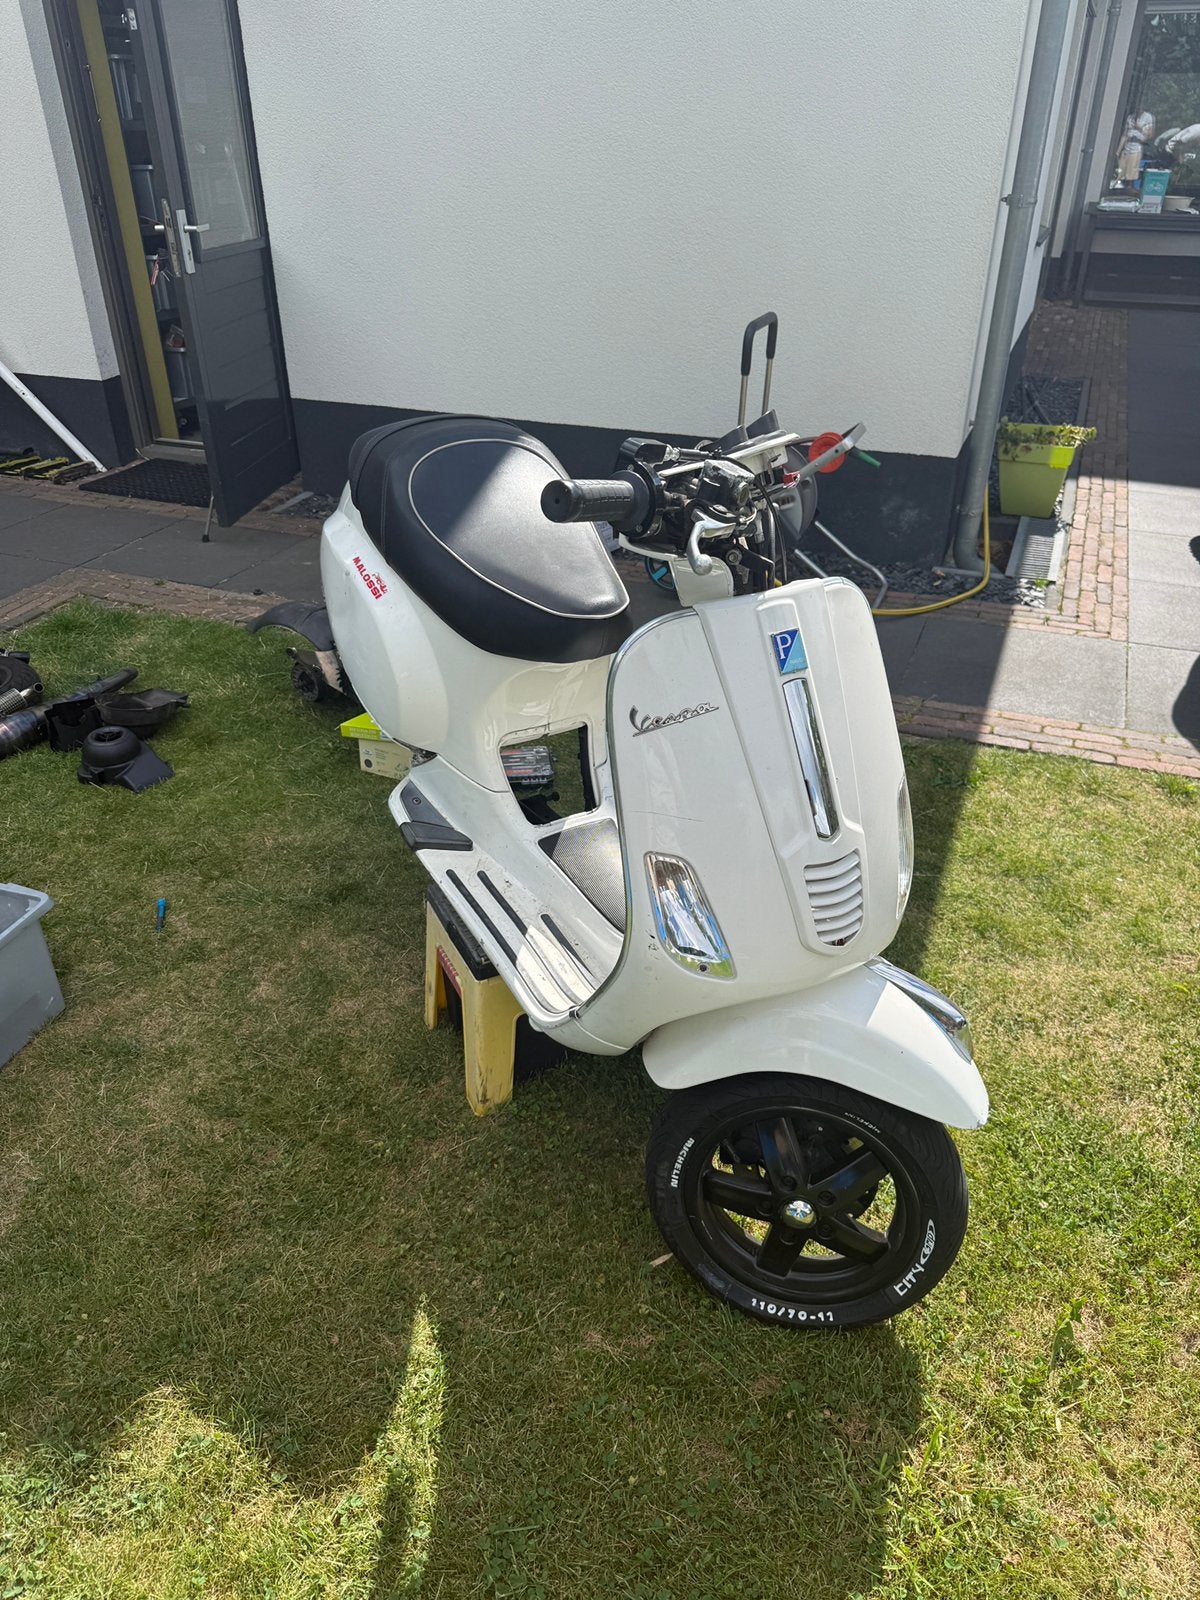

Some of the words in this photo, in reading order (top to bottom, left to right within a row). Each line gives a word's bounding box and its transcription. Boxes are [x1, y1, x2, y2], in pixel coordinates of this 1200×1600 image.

[353, 556, 383, 600] MALOSSI
[775, 633, 792, 660] P
[629, 702, 719, 737] Vespa
[671, 1137, 695, 1188] MICHELIN
[893, 1262, 925, 1297] CITY
[751, 1298, 834, 1322] 110/70-11
